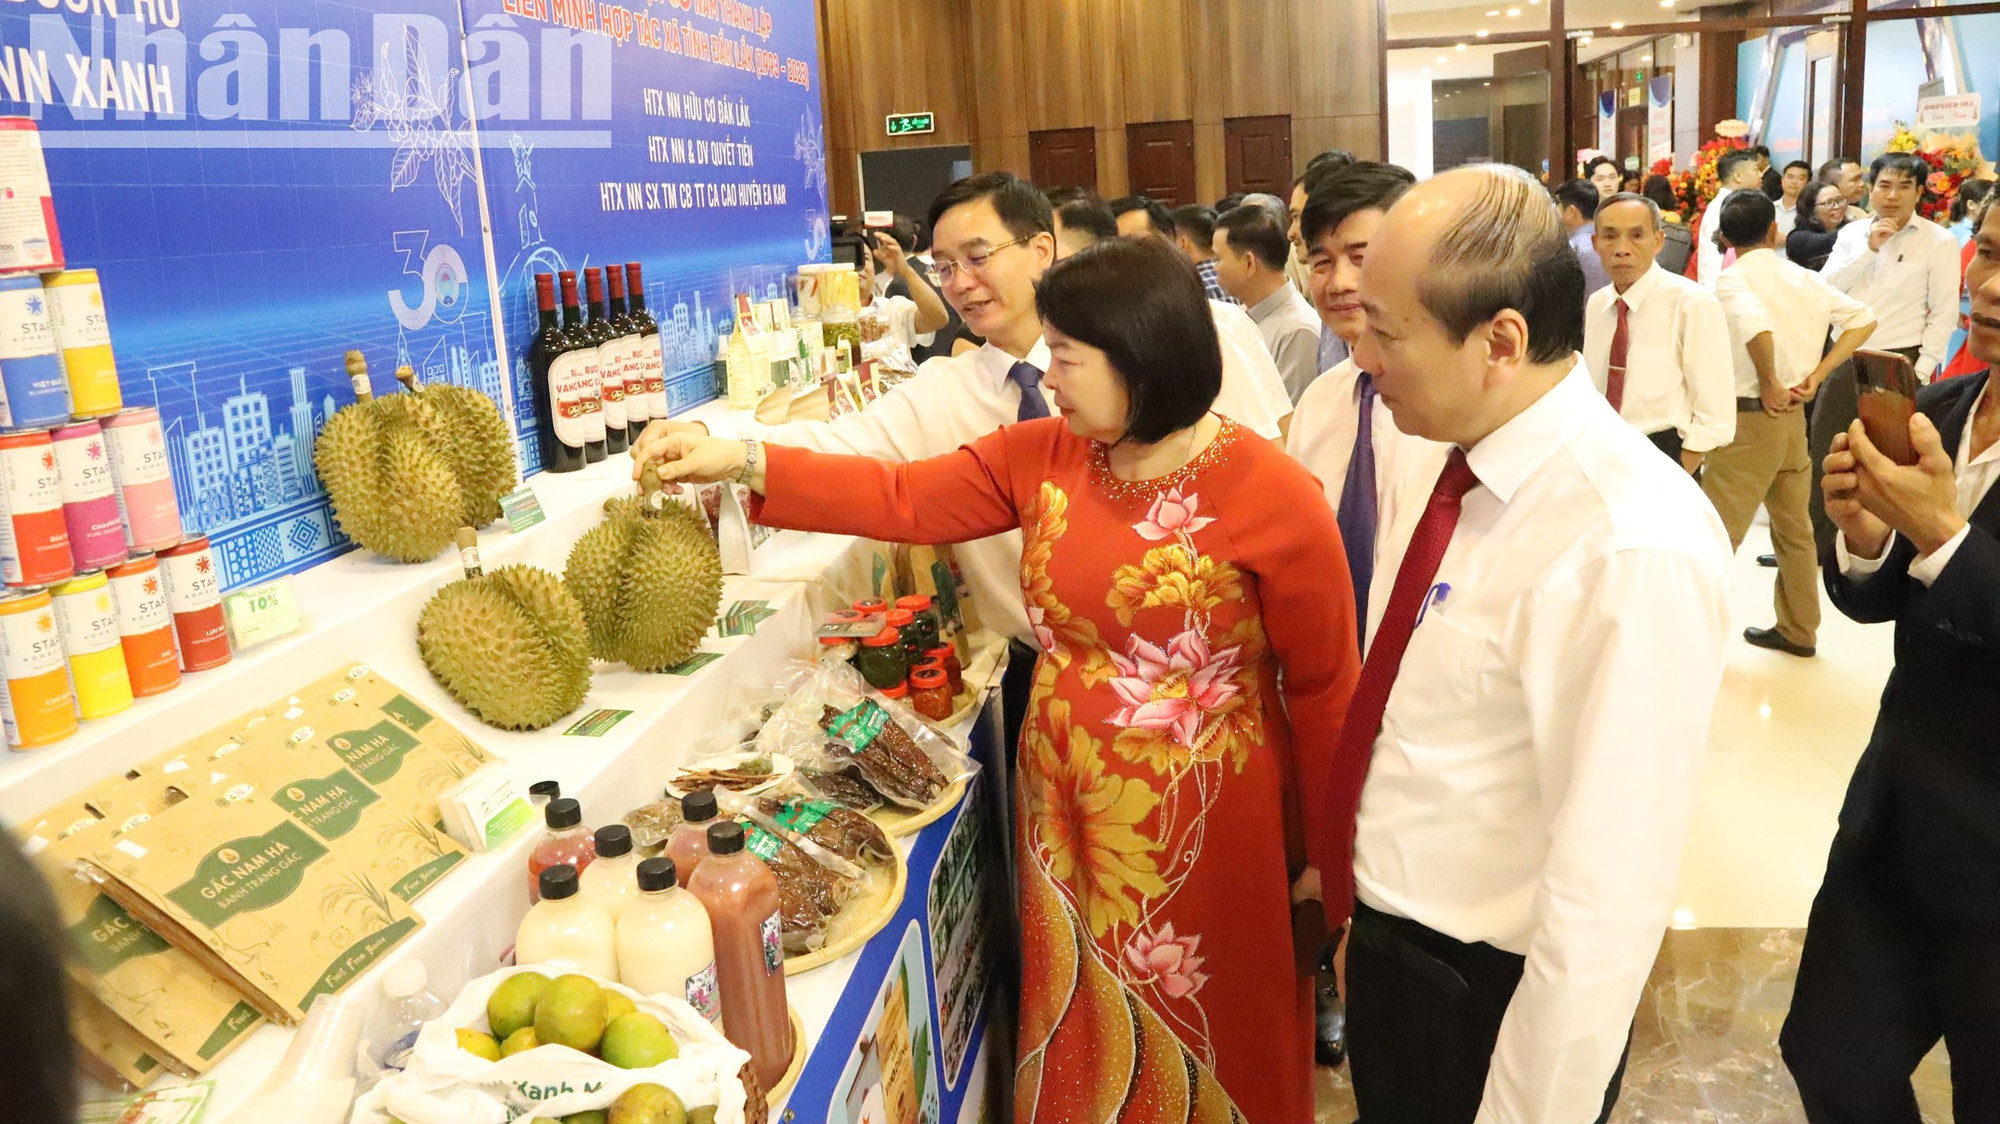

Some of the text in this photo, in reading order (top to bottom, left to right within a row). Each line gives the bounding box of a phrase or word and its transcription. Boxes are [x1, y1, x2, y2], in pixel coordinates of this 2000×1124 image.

[754, 6, 772, 43] LẬP
[552, 0, 597, 34] MINH
[600, 3, 633, 47] HỢP
[633, 9, 661, 49] TÁC
[662, 18, 682, 54] XÃ
[681, 21, 710, 62] TỈNH
[755, 48, 779, 80] (1993
[787, 58, 810, 91] 2023)
[65, 53, 174, 114] XANH
[644, 88, 664, 116] HTX
[666, 91, 681, 118] NN
[683, 90, 702, 121] HỮU
[648, 136, 669, 163] HTX
[671, 138, 685, 164] NN
[688, 139, 695, 164] &
[696, 140, 708, 165] DV
[710, 134, 735, 166] QUYẾT
[600, 180, 786, 211] HTX NN SX TM CB TT CA CAO HUYỆN EA KAR
[250, 593, 279, 613] 10%
[346, 744, 374, 762] NAM
[298, 795, 330, 816] NAM
[231, 854, 269, 880] NAM
[264, 840, 290, 859] HÀ
